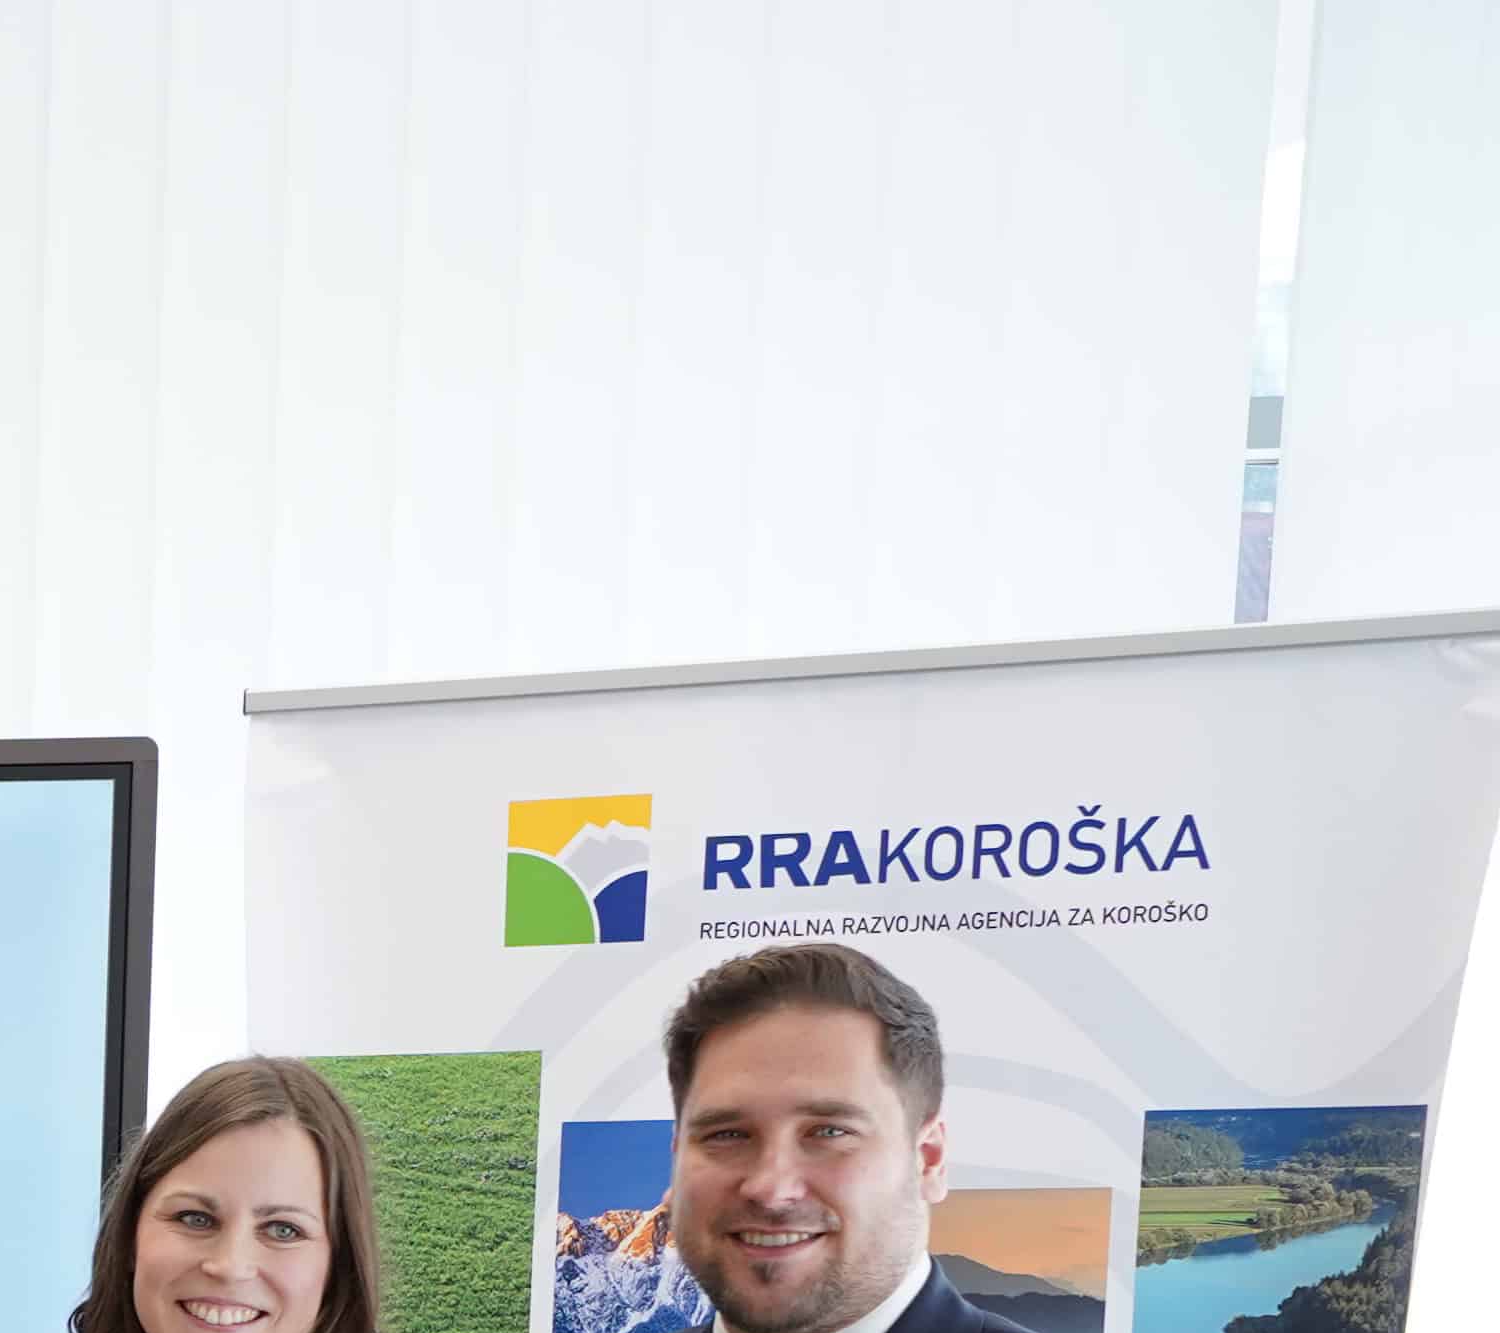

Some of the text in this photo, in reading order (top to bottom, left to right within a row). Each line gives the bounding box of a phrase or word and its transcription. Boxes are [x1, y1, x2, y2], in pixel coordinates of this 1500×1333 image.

[703, 804, 1212, 890] RRAKOROŠKA
[699, 900, 1211, 940] REGIONALNA RAZVOJNA AGENCIJA ZA KOROŠKO
